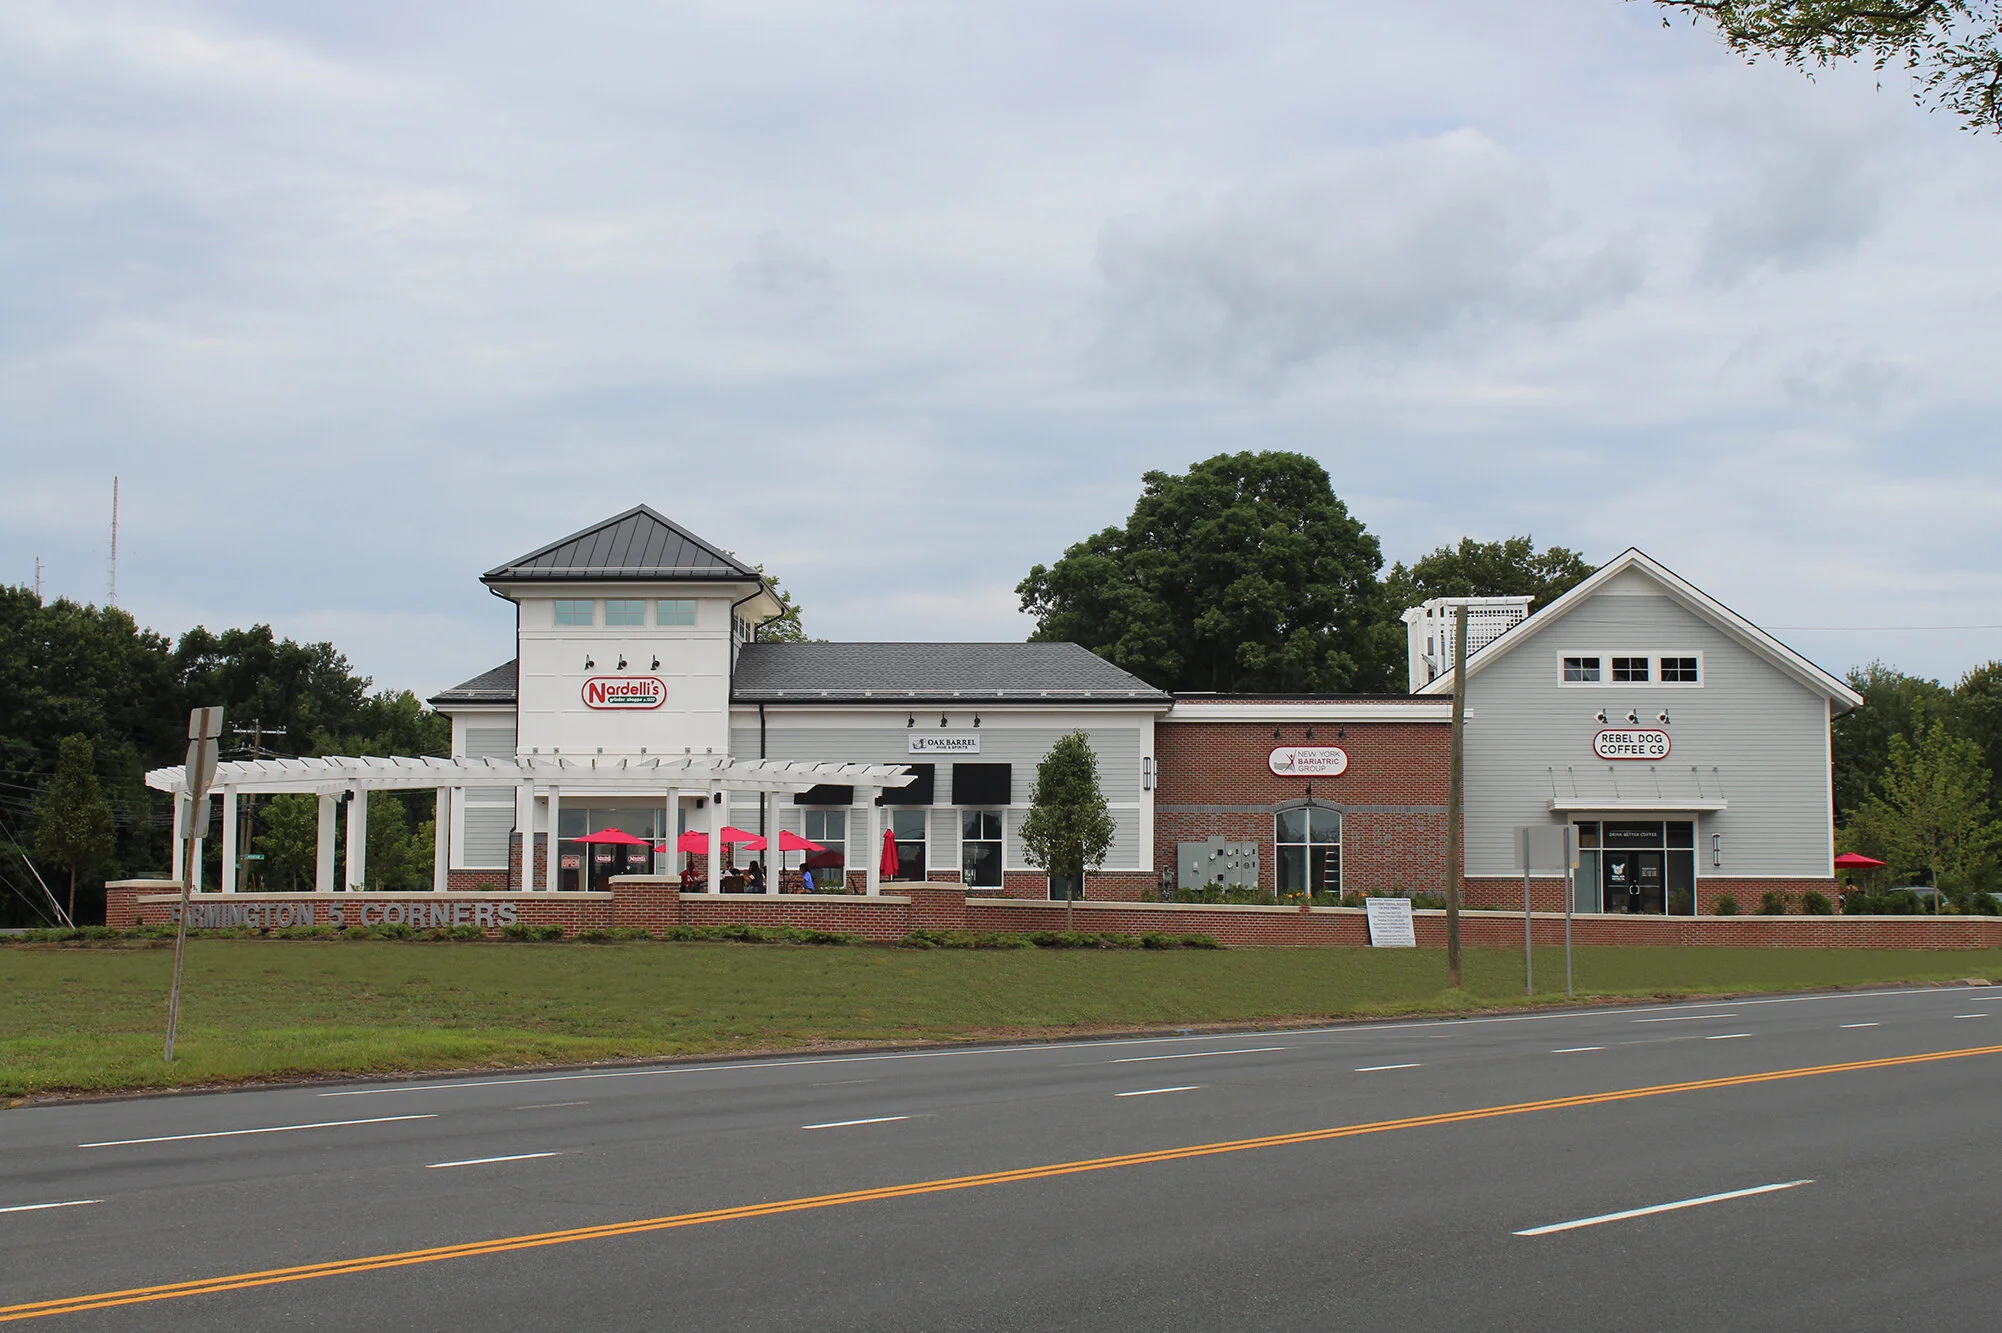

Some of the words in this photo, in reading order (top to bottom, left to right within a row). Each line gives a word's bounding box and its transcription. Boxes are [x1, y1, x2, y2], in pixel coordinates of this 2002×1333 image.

[589, 680, 659, 703] Nardelli's
[1602, 734, 1634, 743] REBEL
[1638, 734, 1663, 743] DOG
[1600, 745, 1645, 754] COFFEE
[328, 903, 345, 928] 5
[360, 903, 518, 929] CORNERS
